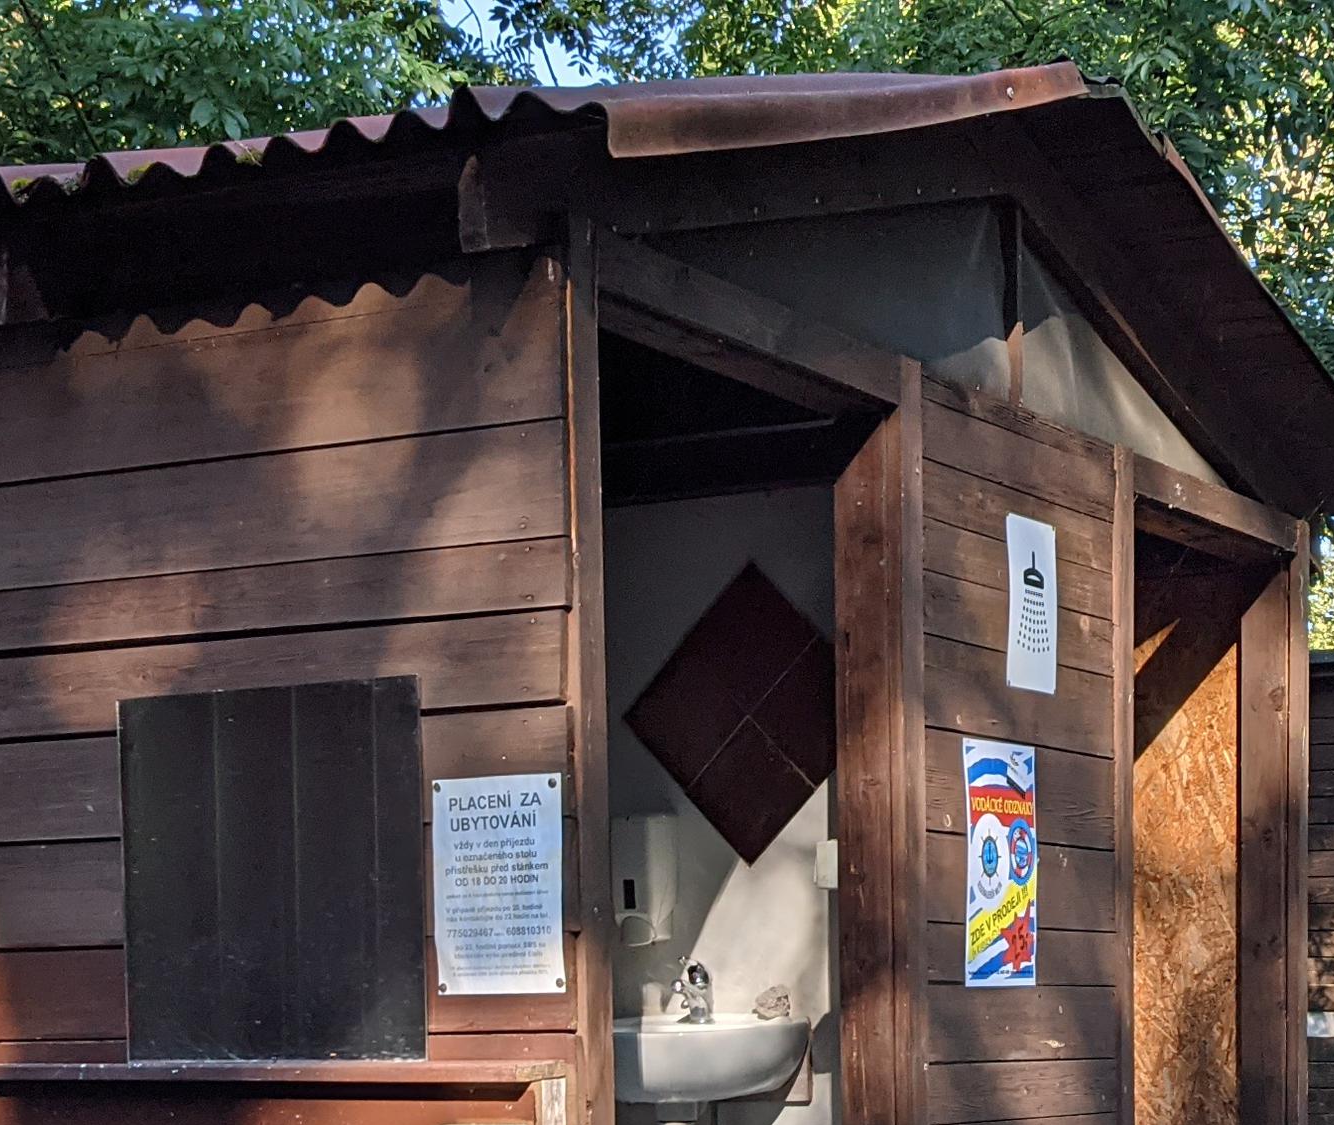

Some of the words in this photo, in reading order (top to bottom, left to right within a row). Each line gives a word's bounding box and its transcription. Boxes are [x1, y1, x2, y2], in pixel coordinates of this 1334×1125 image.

[449, 790, 511, 811] PLACENÍ
[520, 792, 541, 807] ZA
[450, 810, 536, 832] UBYTOVÁNÍ
[483, 839, 499, 848] den
[455, 878, 469, 887] OD
[483, 876, 497, 885] DO
[970, 923, 985, 946] ZDE
[985, 917, 991, 931] V
[992, 891, 1021, 927] PRODEJI
